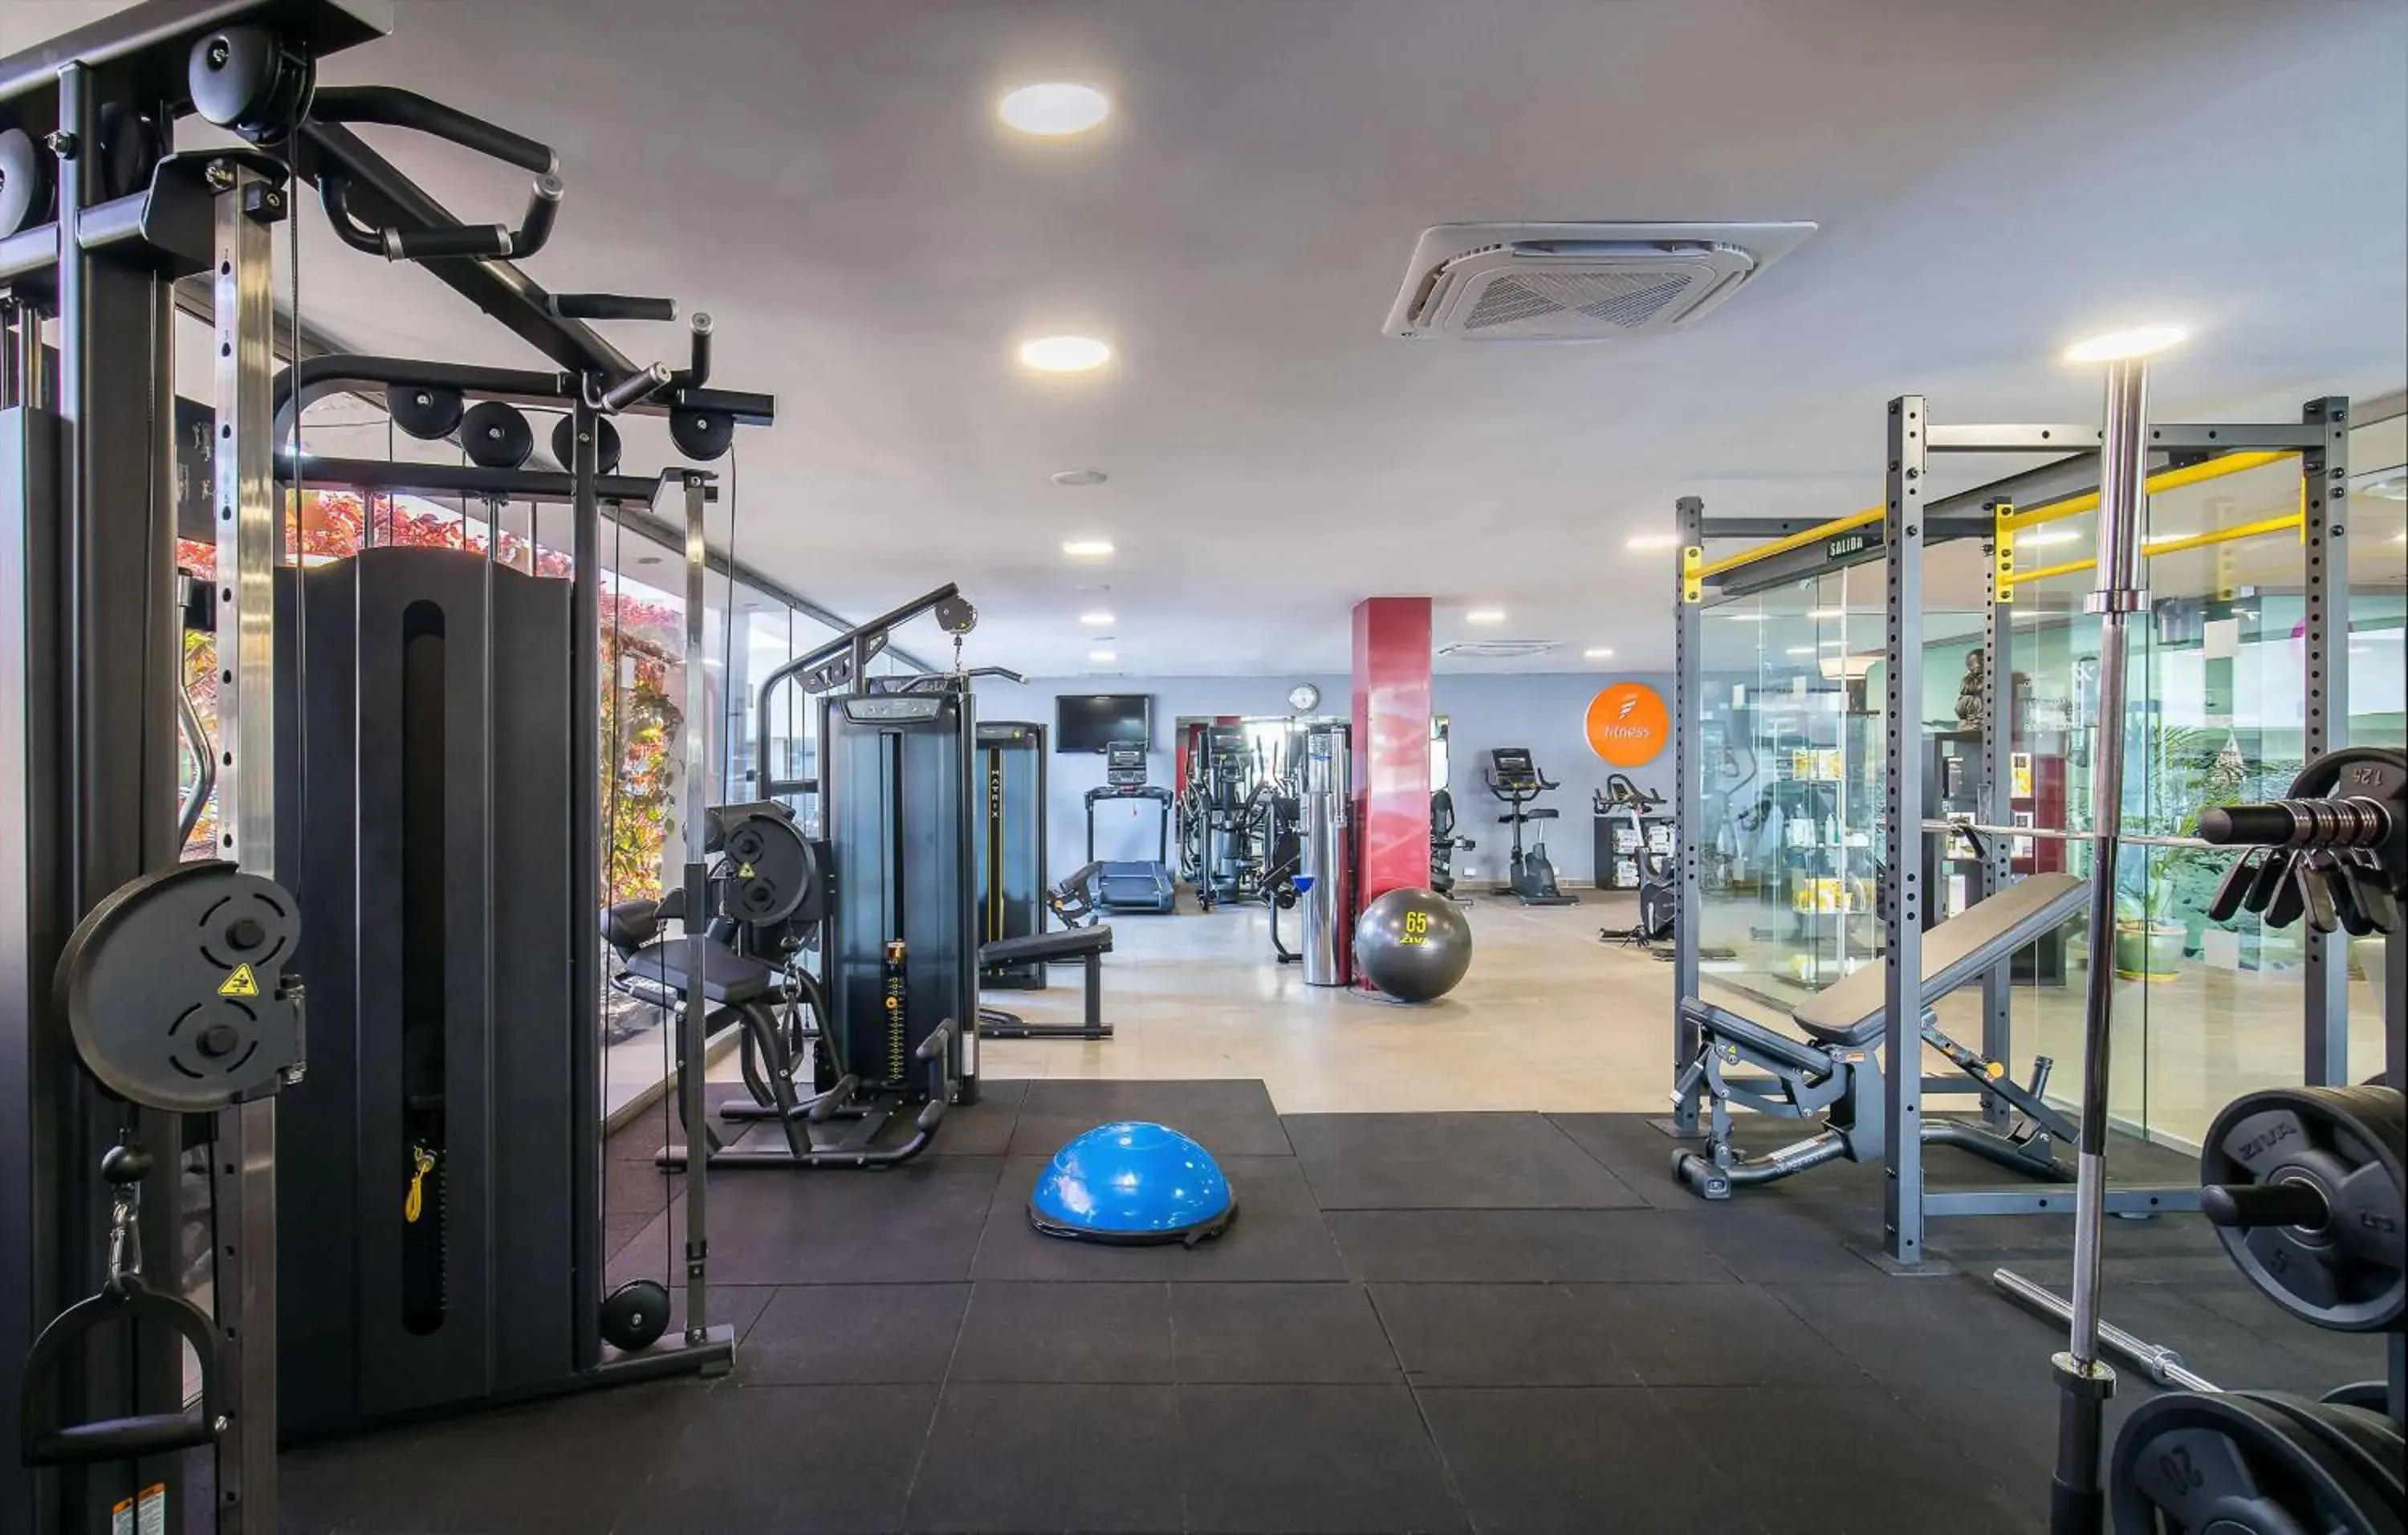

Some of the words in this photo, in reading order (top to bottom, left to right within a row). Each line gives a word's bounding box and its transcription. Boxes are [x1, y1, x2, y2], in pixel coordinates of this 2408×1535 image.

[991, 770, 1000, 818] MATRIX
[1405, 911, 1426, 933] 65
[2239, 1122, 2298, 1161] ZIVA
[2271, 1247, 2292, 1274] 5
